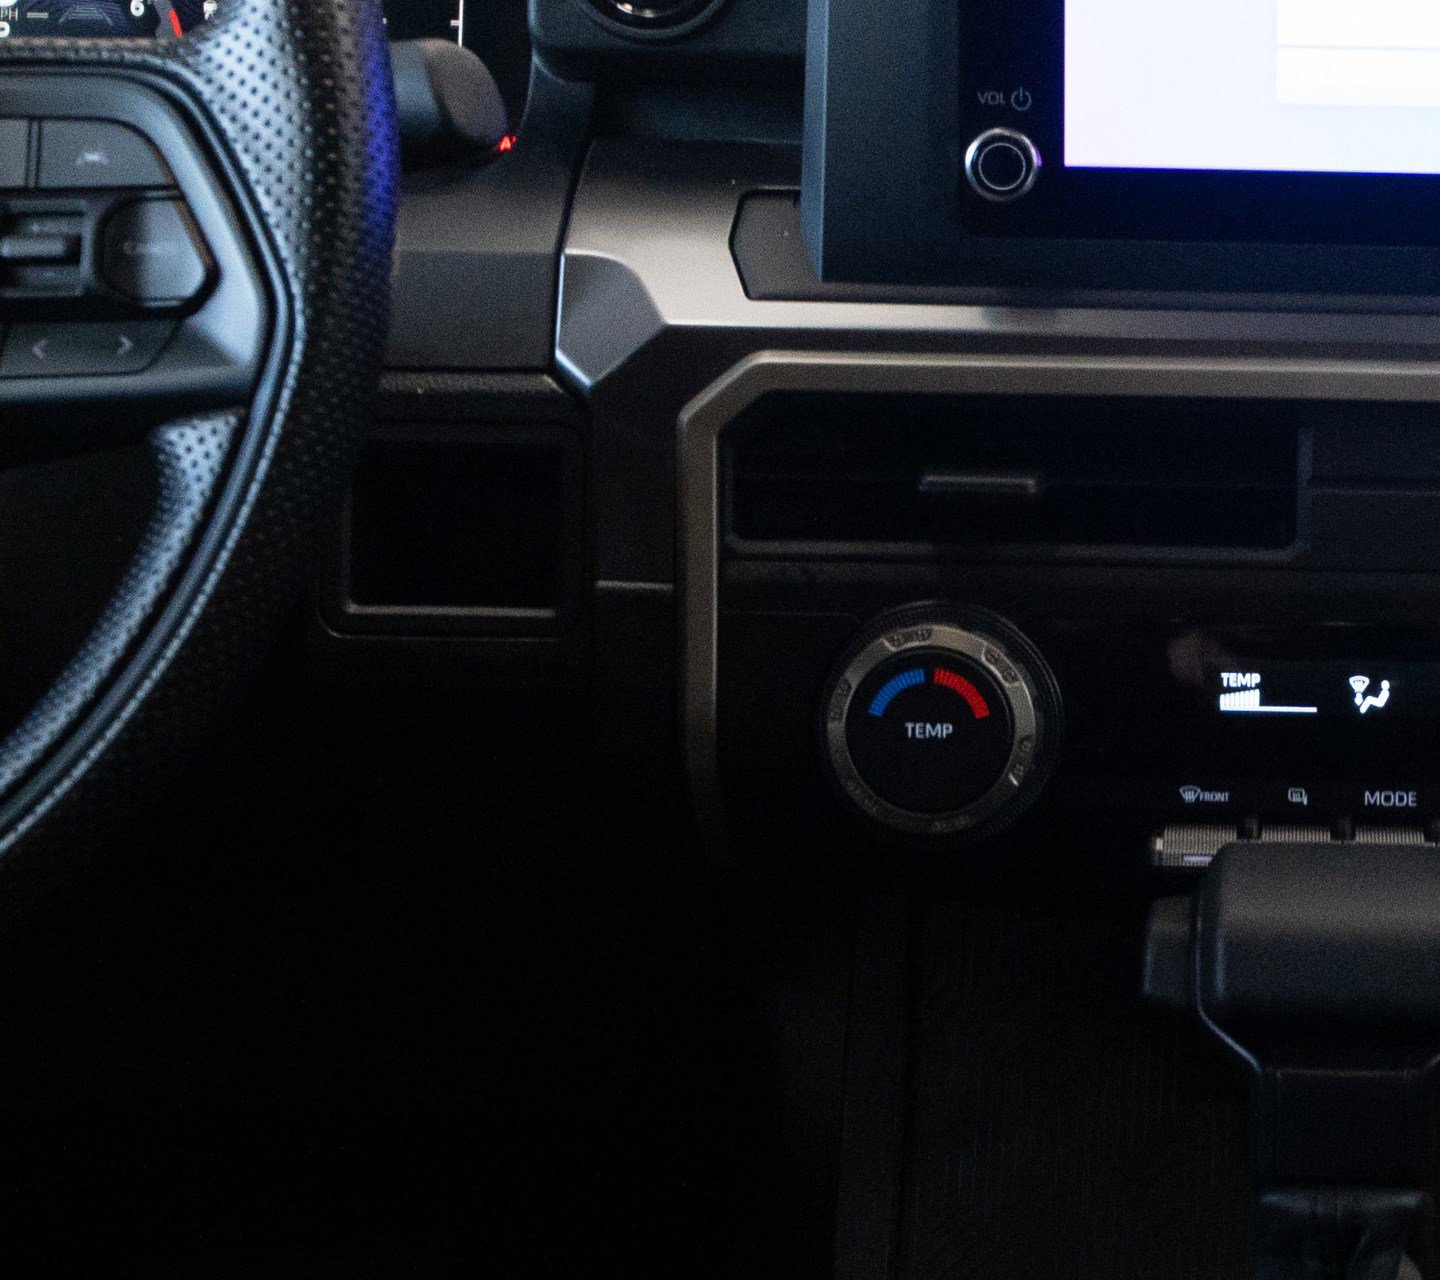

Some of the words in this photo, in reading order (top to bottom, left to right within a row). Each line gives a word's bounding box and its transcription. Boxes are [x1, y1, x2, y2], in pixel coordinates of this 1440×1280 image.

[976, 90, 1006, 106] VOL
[1219, 671, 1262, 689] TEMP
[904, 721, 954, 740] TEMP
[1200, 791, 1230, 804] FRONT
[1364, 790, 1418, 808] MODE
